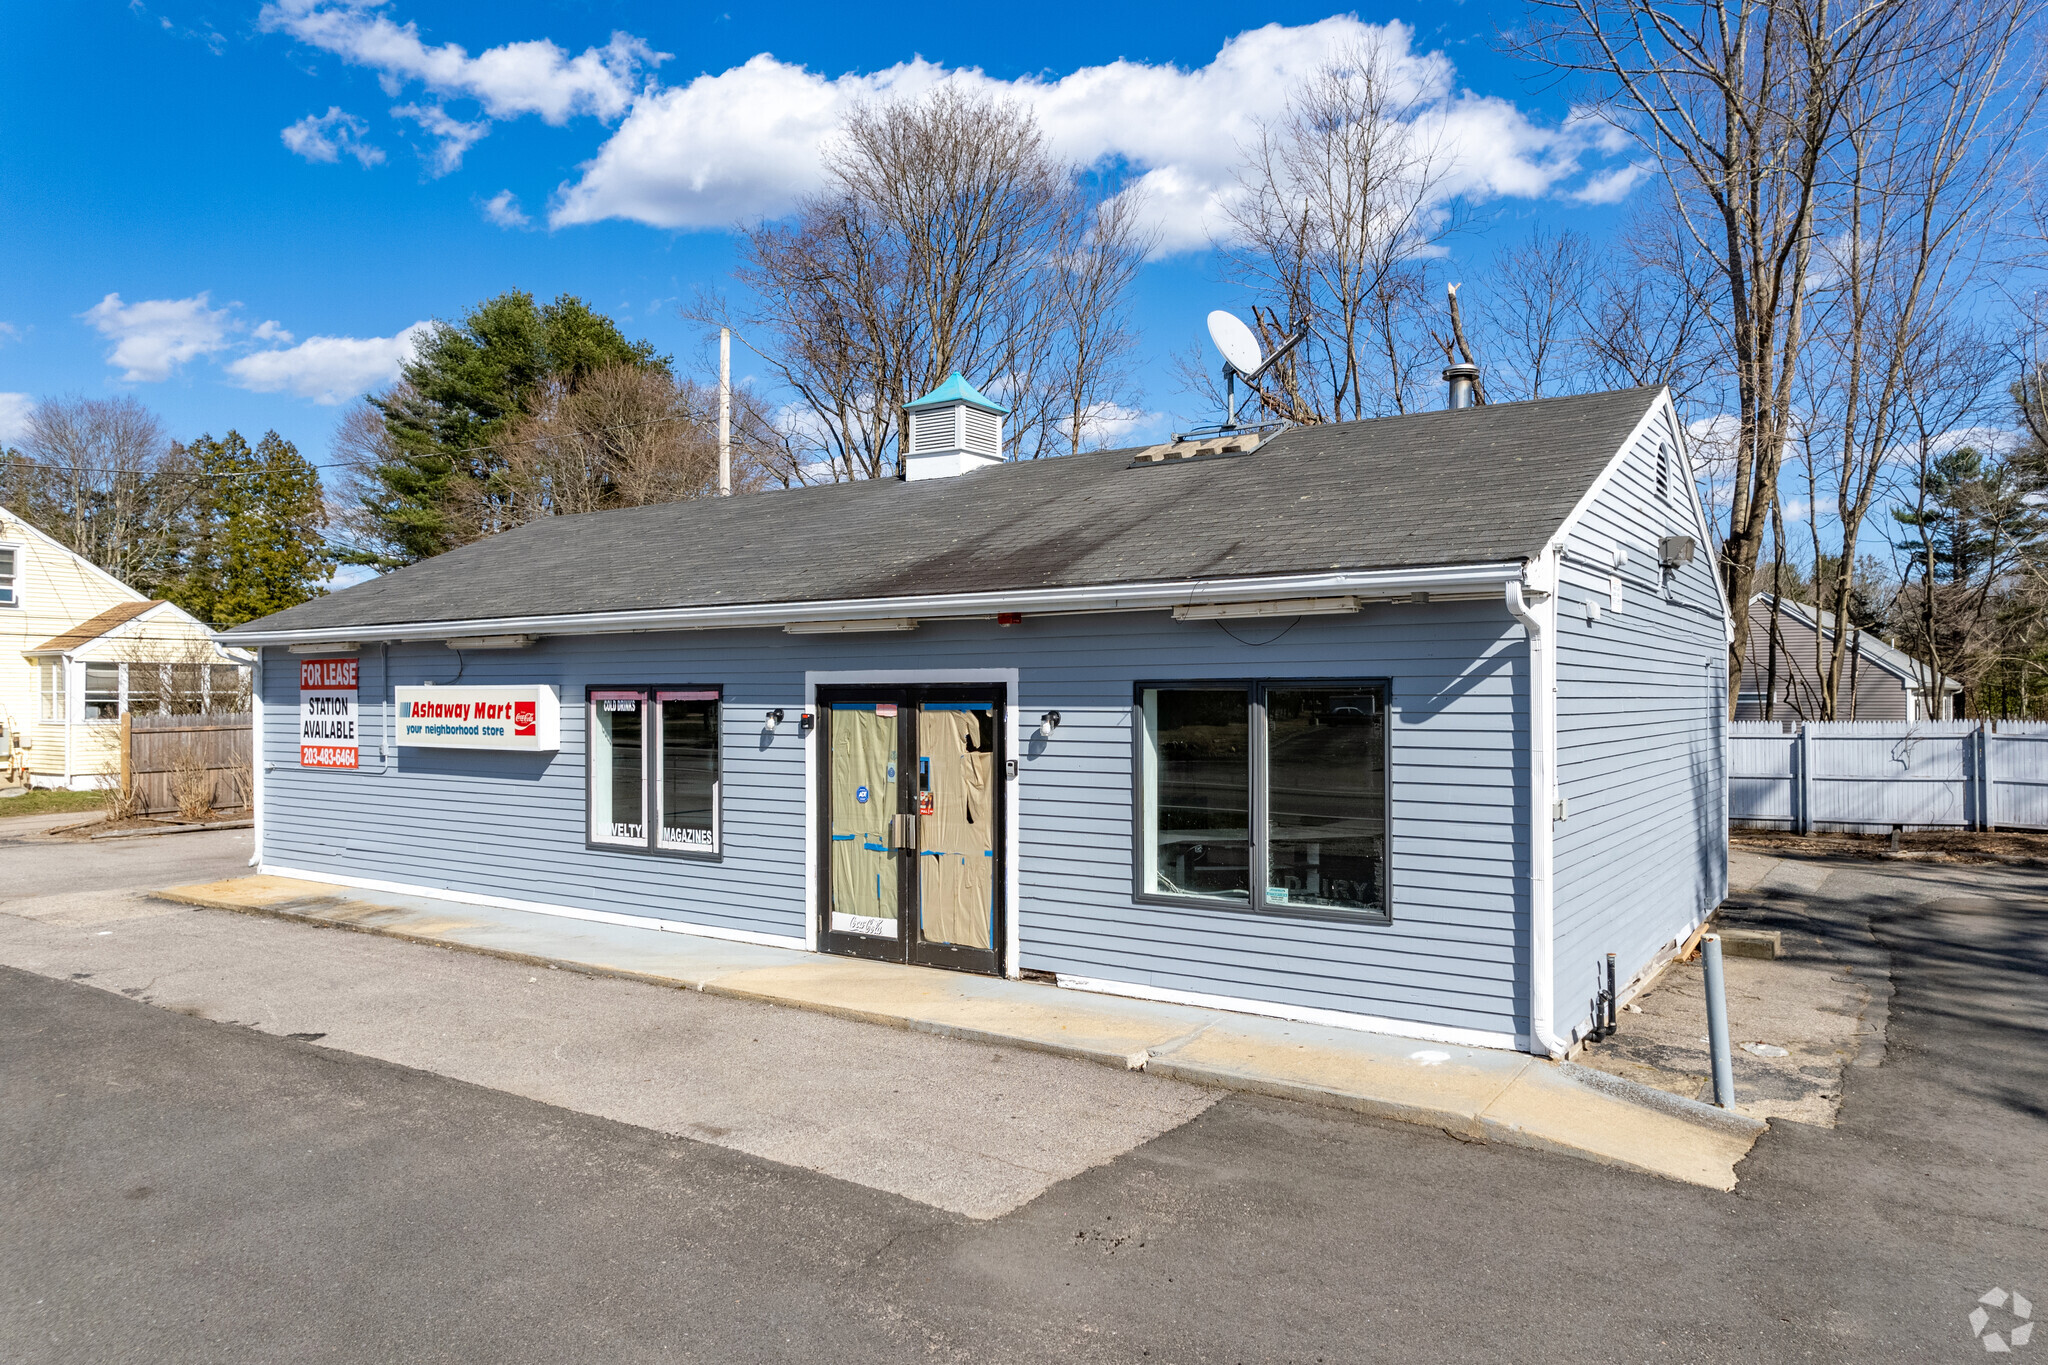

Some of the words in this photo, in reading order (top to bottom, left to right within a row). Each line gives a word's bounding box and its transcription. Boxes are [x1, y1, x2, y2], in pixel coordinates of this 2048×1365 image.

[301, 664, 321, 686] FOR
[324, 662, 356, 686] LEASE
[309, 697, 348, 715] STATION
[411, 701, 470, 721] Ashaway
[474, 702, 512, 720] Mart
[604, 700, 616, 711] COLD
[617, 700, 636, 711] DRINKS
[303, 720, 354, 739] AVAILABLE
[406, 725, 422, 735] your
[425, 723, 479, 736] neighborhood
[482, 725, 505, 736] store
[303, 747, 355, 766] 203-483-6464
[663, 827, 712, 844] MAGAZINES
